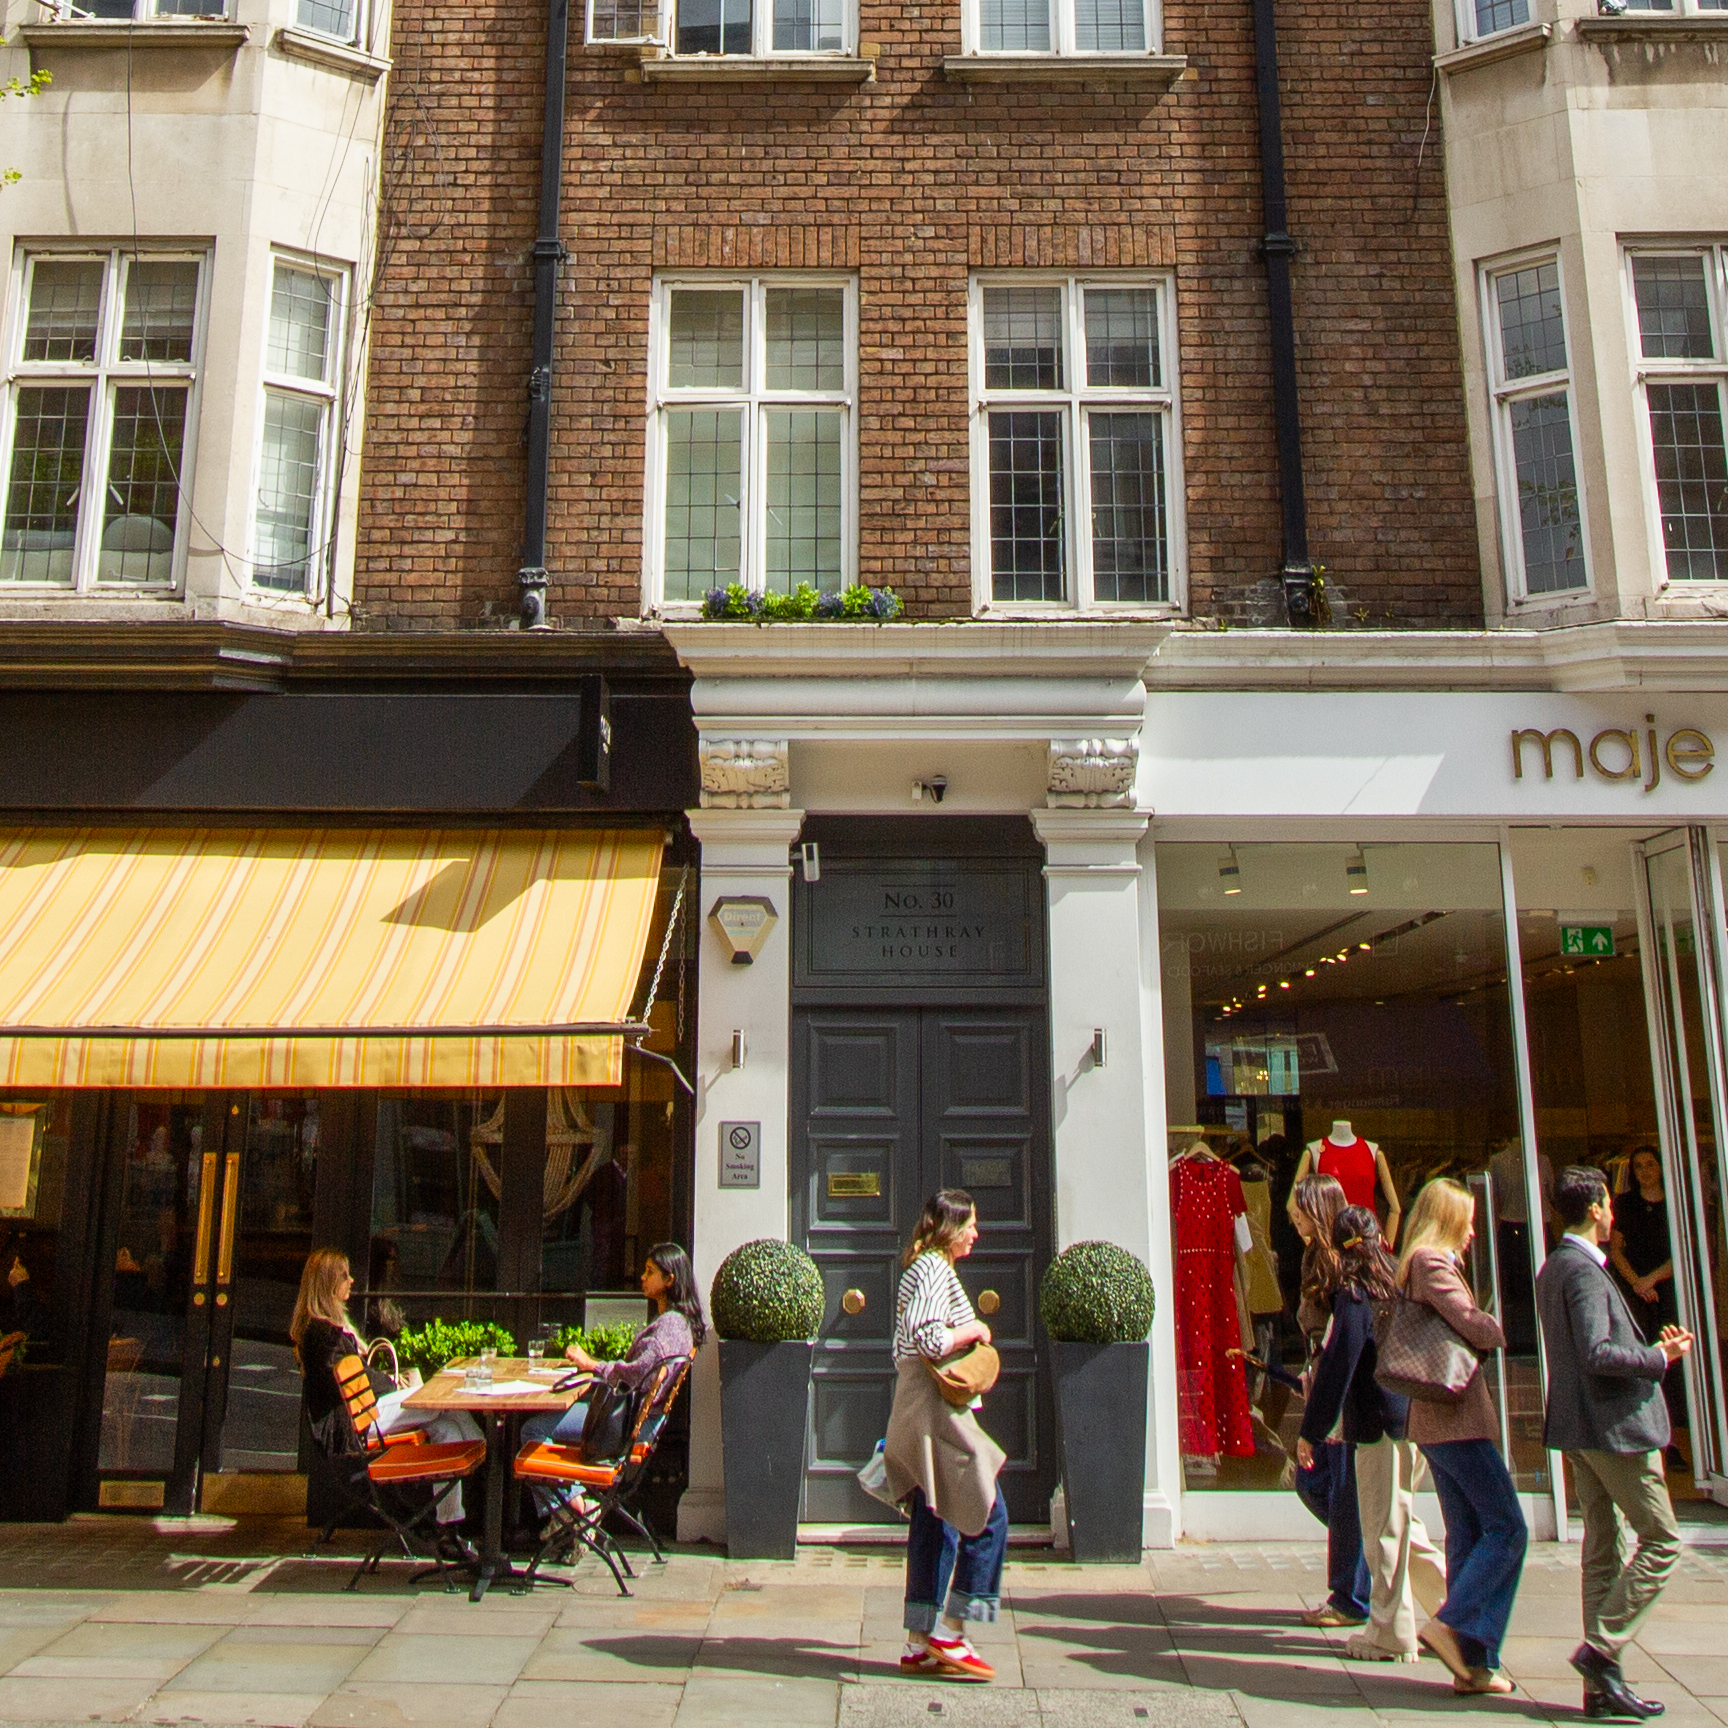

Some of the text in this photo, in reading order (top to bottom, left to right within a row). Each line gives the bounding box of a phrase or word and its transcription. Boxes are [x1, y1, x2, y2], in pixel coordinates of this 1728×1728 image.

[1511, 713, 1715, 792] maje
[932, 892, 954, 909] 30
[852, 926, 985, 939] STRATHRAY
[882, 945, 957, 958] HOUSE
[726, 1163, 754, 1171] Smoking
